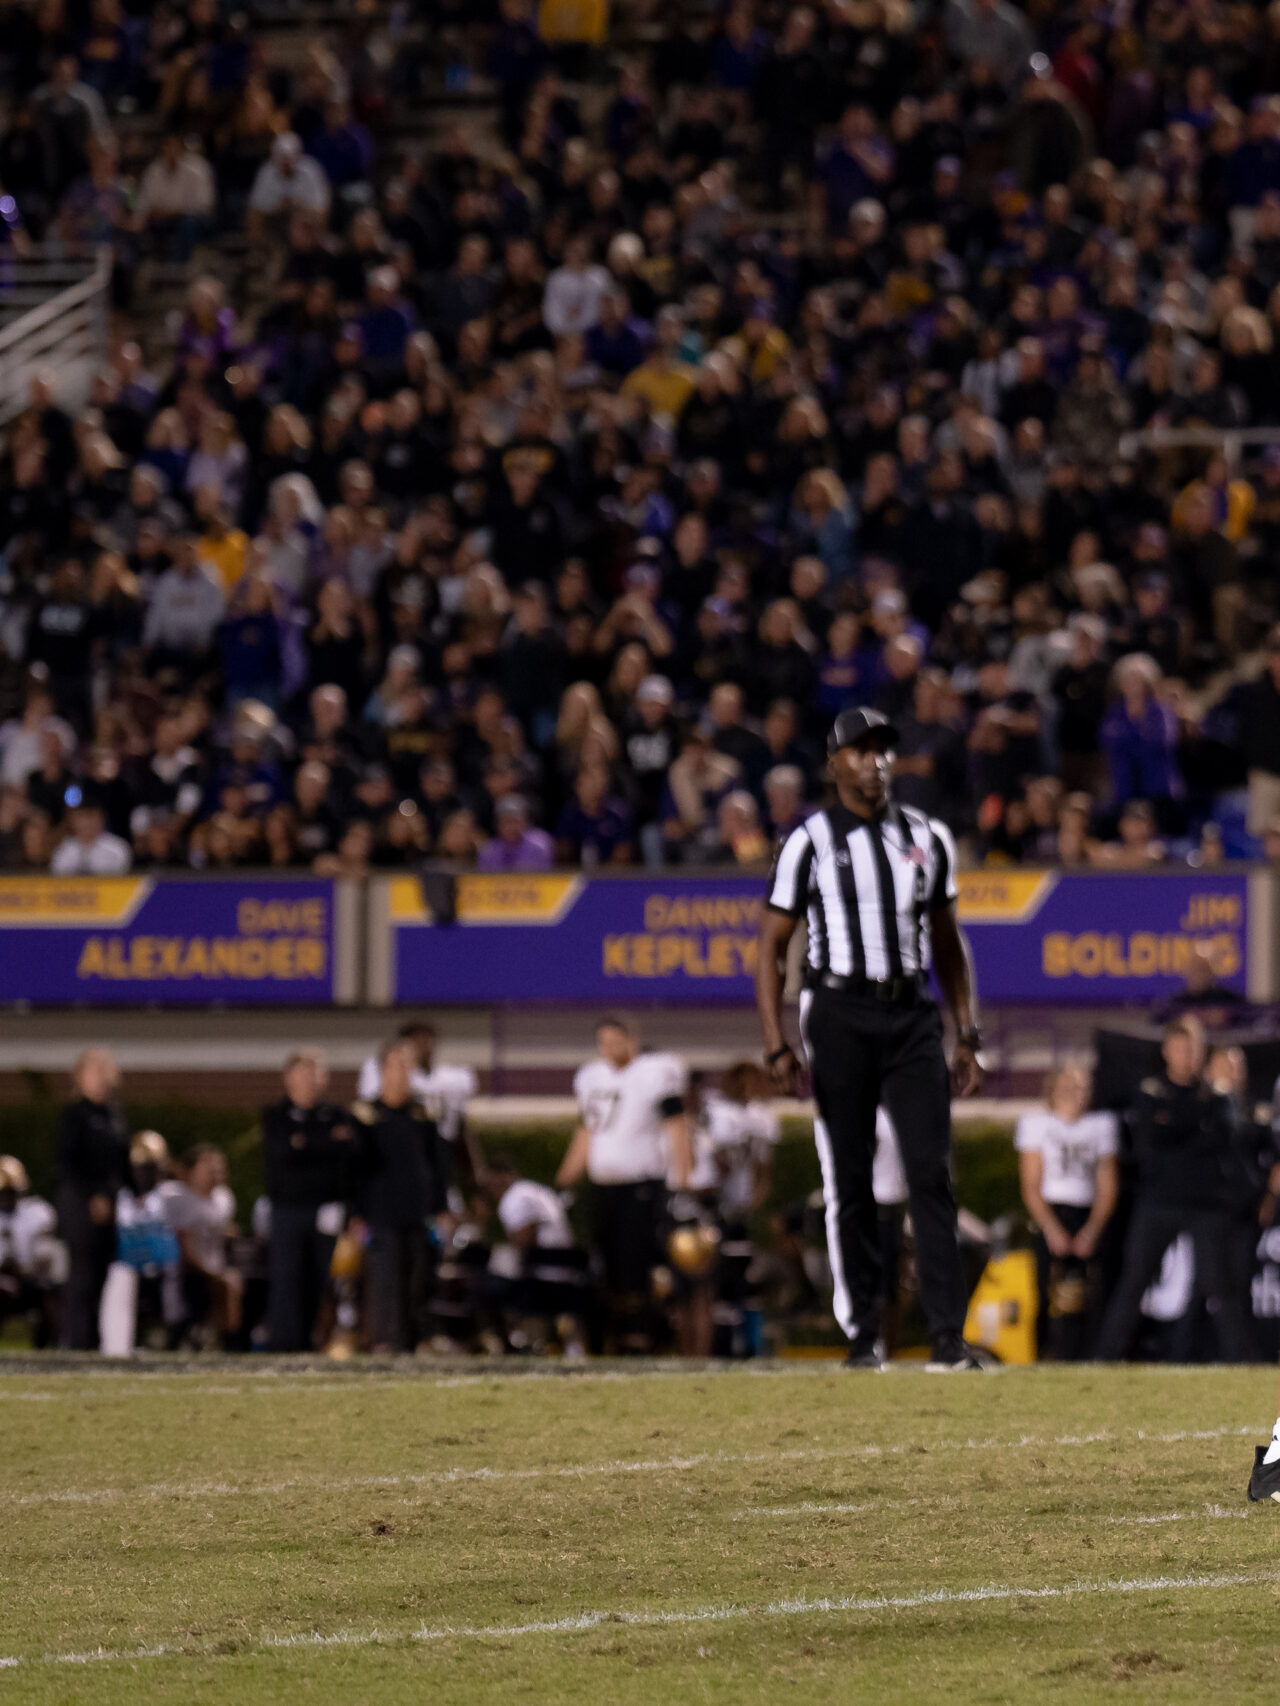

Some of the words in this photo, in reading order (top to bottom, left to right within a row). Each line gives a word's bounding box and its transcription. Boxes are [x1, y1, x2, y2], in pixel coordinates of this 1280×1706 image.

[236, 897, 325, 933] DAVE
[644, 895, 766, 930] DANNY
[1180, 894, 1242, 930] JIM
[77, 935, 326, 979] ALEXANDER
[602, 934, 760, 977] KEPLEY
[1041, 933, 1241, 978] BOLDING
